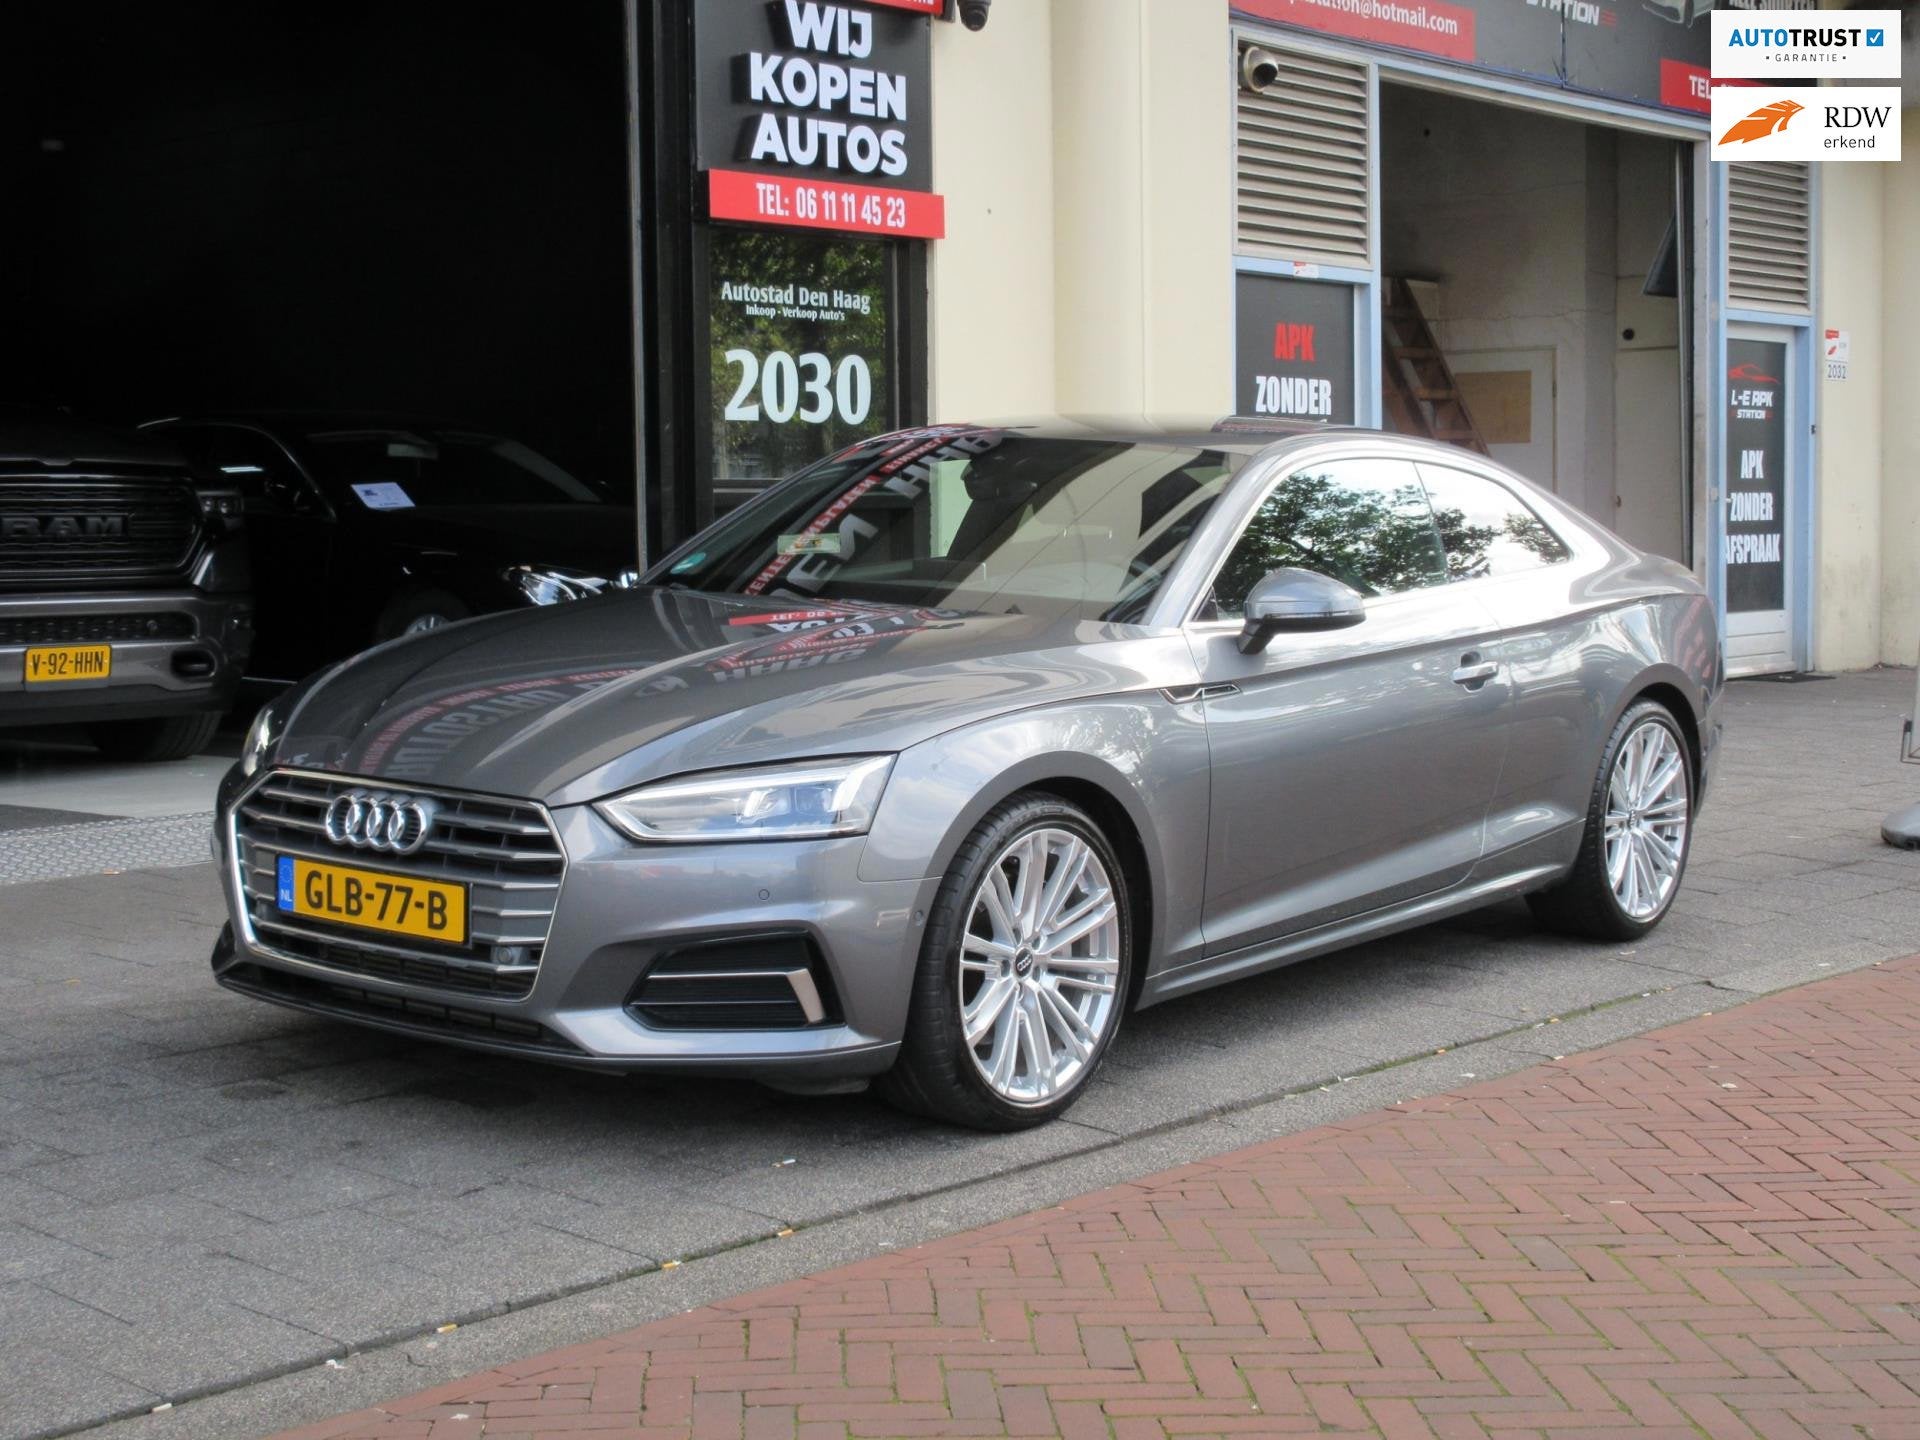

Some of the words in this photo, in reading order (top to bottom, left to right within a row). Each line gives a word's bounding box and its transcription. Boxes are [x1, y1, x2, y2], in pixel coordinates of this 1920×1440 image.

[785, 0, 872, 58] WIJ
[750, 51, 906, 121] KOPEN
[751, 112, 908, 176] AUTOS
[756, 182, 789, 217] TEL:
[796, 187, 817, 219] 06
[822, 190, 837, 221] 11
[841, 192, 856, 223] 11
[861, 195, 881, 226] 45
[886, 197, 905, 228] 23
[721, 281, 794, 304] Autostad
[799, 287, 828, 307] Den
[834, 289, 870, 315] Haag
[746, 304, 776, 319] Inkoop
[782, 306, 818, 322] Verkoop
[819, 310, 845, 321] Auto's
[1274, 323, 1315, 362] APK
[724, 349, 871, 425] 2030
[1828, 364, 1846, 379] 2032
[1256, 376, 1331, 415] ZONDER
[1731, 389, 1751, 406] L-E
[1741, 450, 1764, 479] APK
[1730, 492, 1773, 521] ZONDER
[2, 516, 122, 537] RAM
[32, 651, 104, 675] V-92-HHN
[280, 889, 292, 902] NL
[305, 870, 448, 930] GLB-77-B
